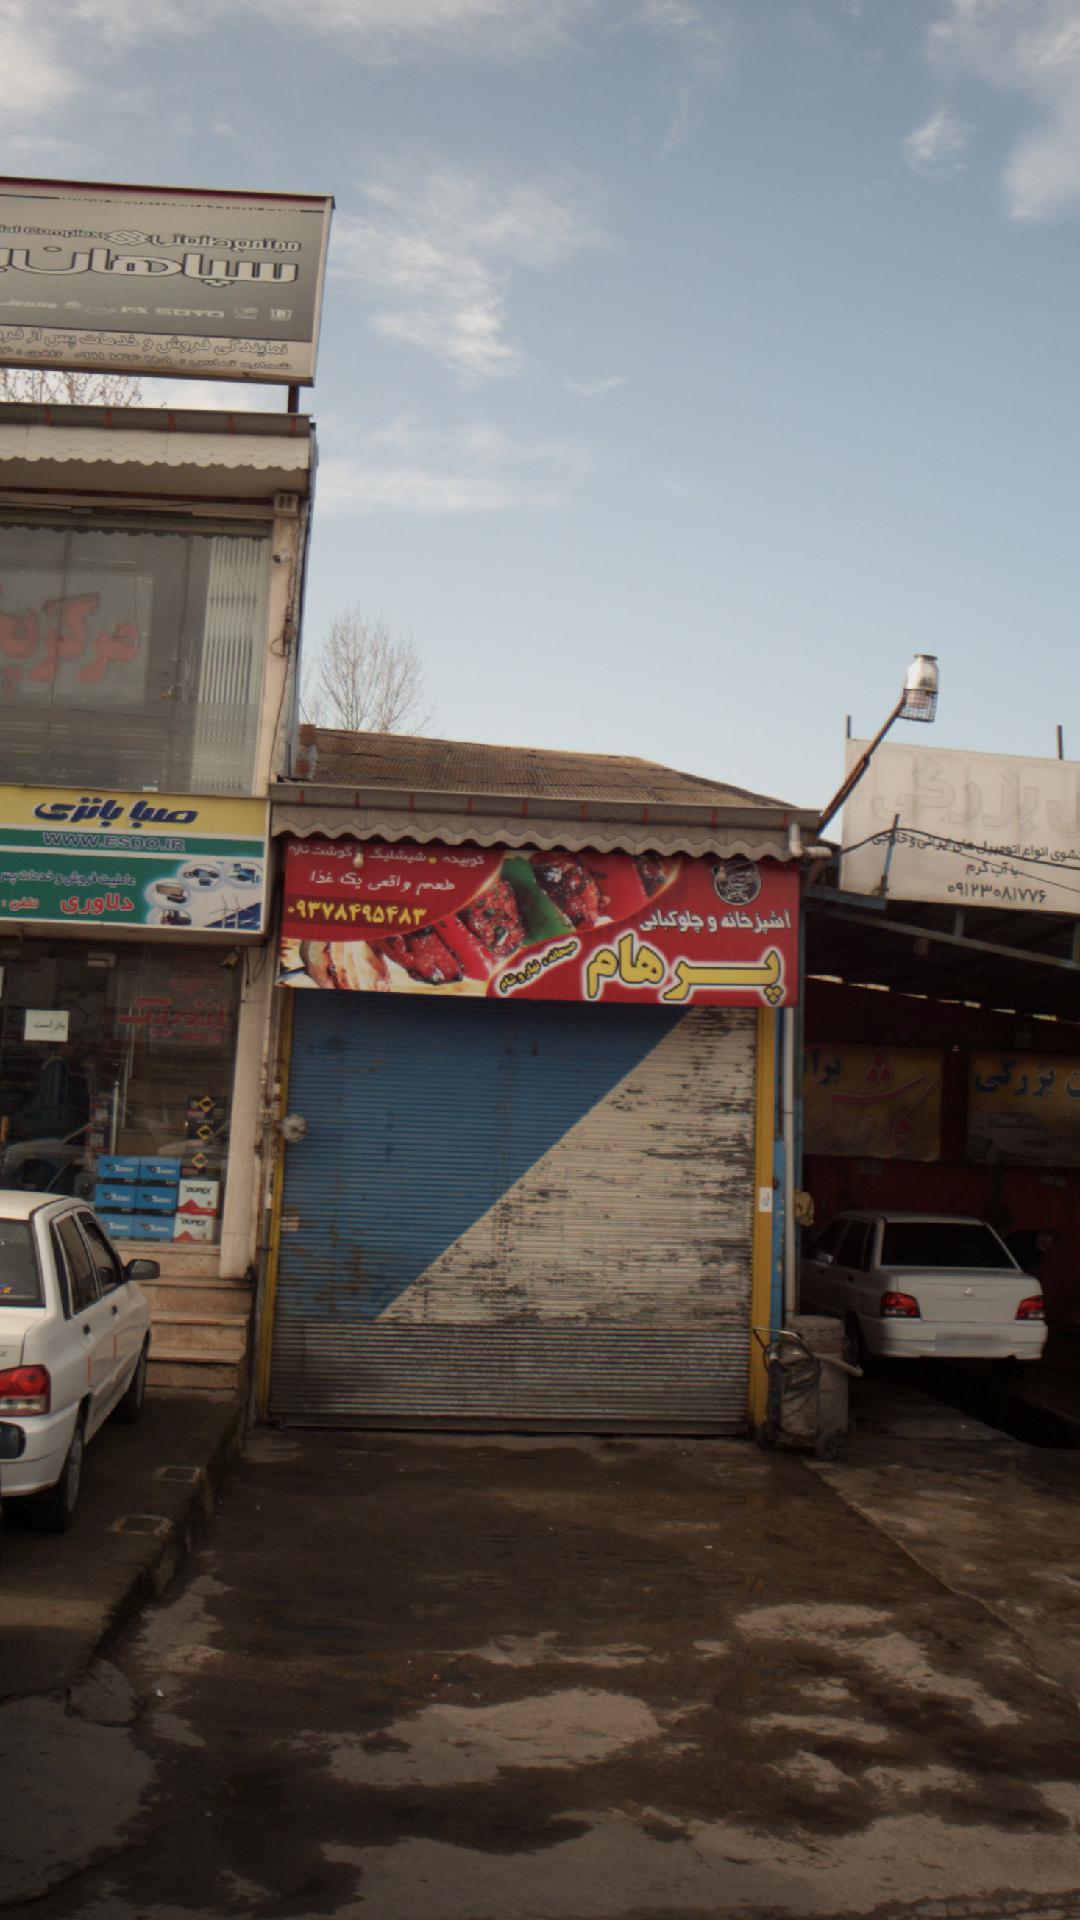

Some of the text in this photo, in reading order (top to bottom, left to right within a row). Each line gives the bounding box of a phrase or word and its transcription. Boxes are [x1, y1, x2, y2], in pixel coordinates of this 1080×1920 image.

[11, 246, 299, 288] سپاهان
[25, 327, 43, 344] از
[44, 334, 77, 348] پس
[80, 333, 139, 346] خدمات
[142, 339, 154, 352] و
[156, 336, 211, 353] فروش
[213, 338, 288, 356] نمایندگی
[34, 797, 199, 828] صبا باتری
[369, 849, 427, 863] شیشلیک
[442, 855, 485, 867] کوبیده
[18, 869, 55, 881] خدمات
[966, 860, 991, 876] گرم
[54, 873, 64, 885] و
[64, 870, 98, 886] فروش
[310, 869, 455, 895] طعم واقعی یک غذا
[60, 892, 134, 915] دلاوری
[287, 899, 427, 926] ۰۹۳۷۸۴۹۵۴۸۳
[640, 909, 704, 933] چلوکبابی
[707, 915, 718, 931] و
[585, 932, 784, 1004] پرهام
